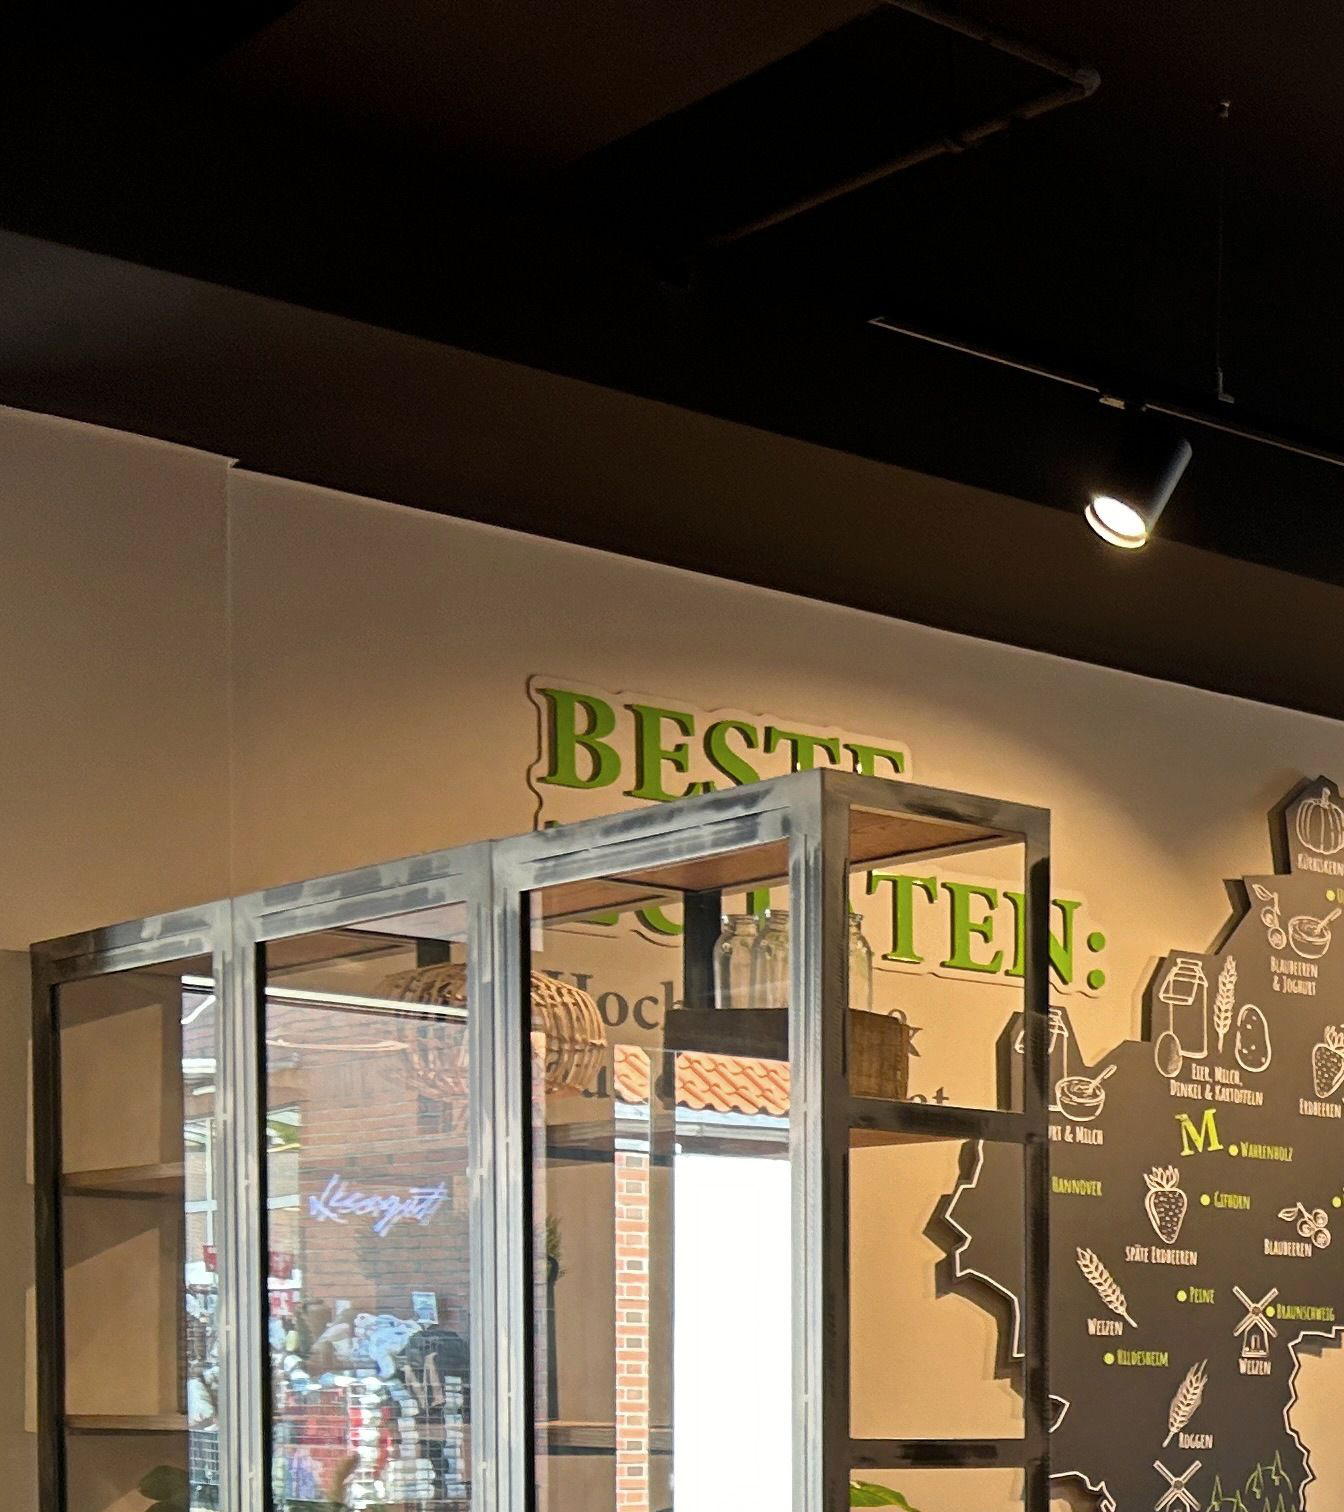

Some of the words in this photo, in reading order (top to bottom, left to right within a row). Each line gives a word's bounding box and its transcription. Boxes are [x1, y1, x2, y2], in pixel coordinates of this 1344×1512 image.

[1273, 975, 1281, 991] &
[1205, 1085, 1213, 1101] &
[1064, 1125, 1073, 1143] &
[1174, 1108, 1224, 1157] M
[1051, 1175, 1102, 1197] HANNOVER
[1087, 1318, 1124, 1336] WEIZEN
[1238, 1358, 1272, 1376] WEIZEN
[1178, 1432, 1213, 1449] ROGGEN
